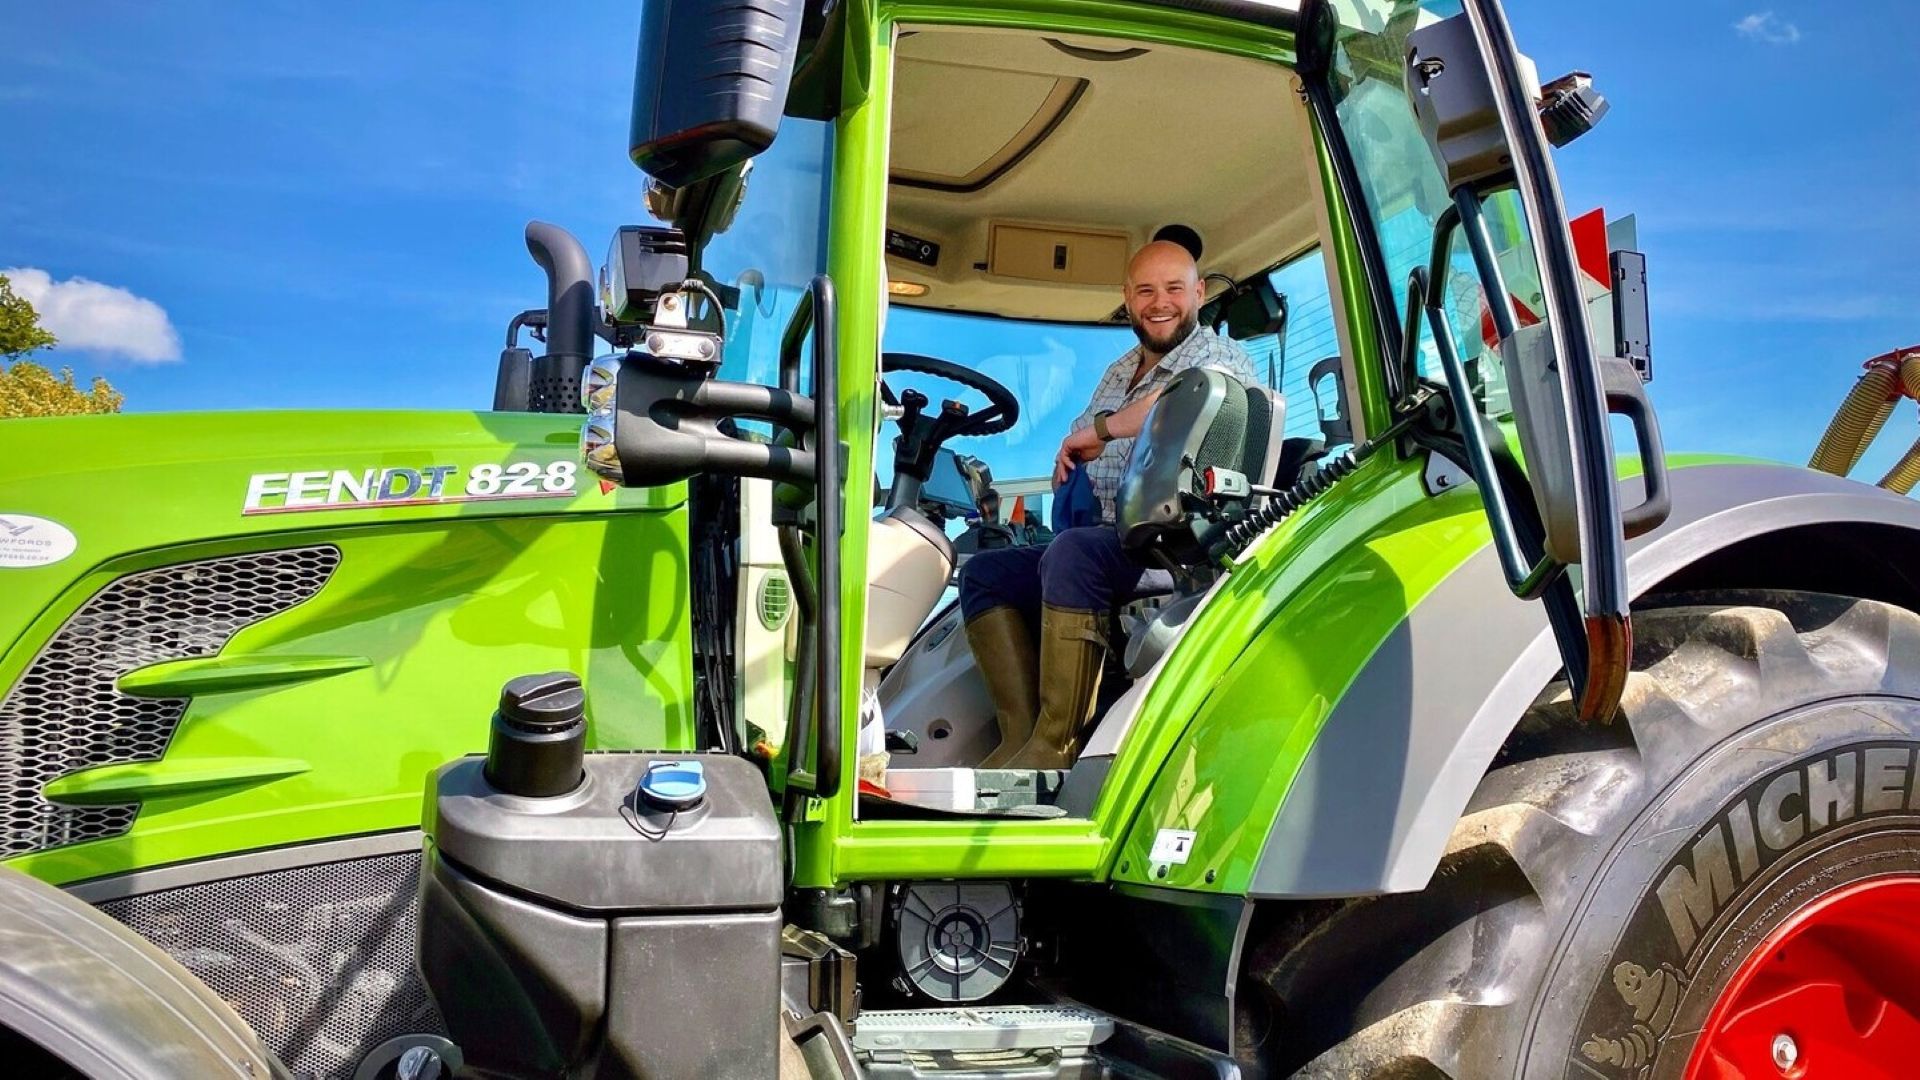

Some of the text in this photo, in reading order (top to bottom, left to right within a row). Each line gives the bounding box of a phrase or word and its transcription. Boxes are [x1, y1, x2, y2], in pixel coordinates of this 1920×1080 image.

[243, 461, 577, 511] FENDT 828
[1656, 747, 1920, 958] MICHE
